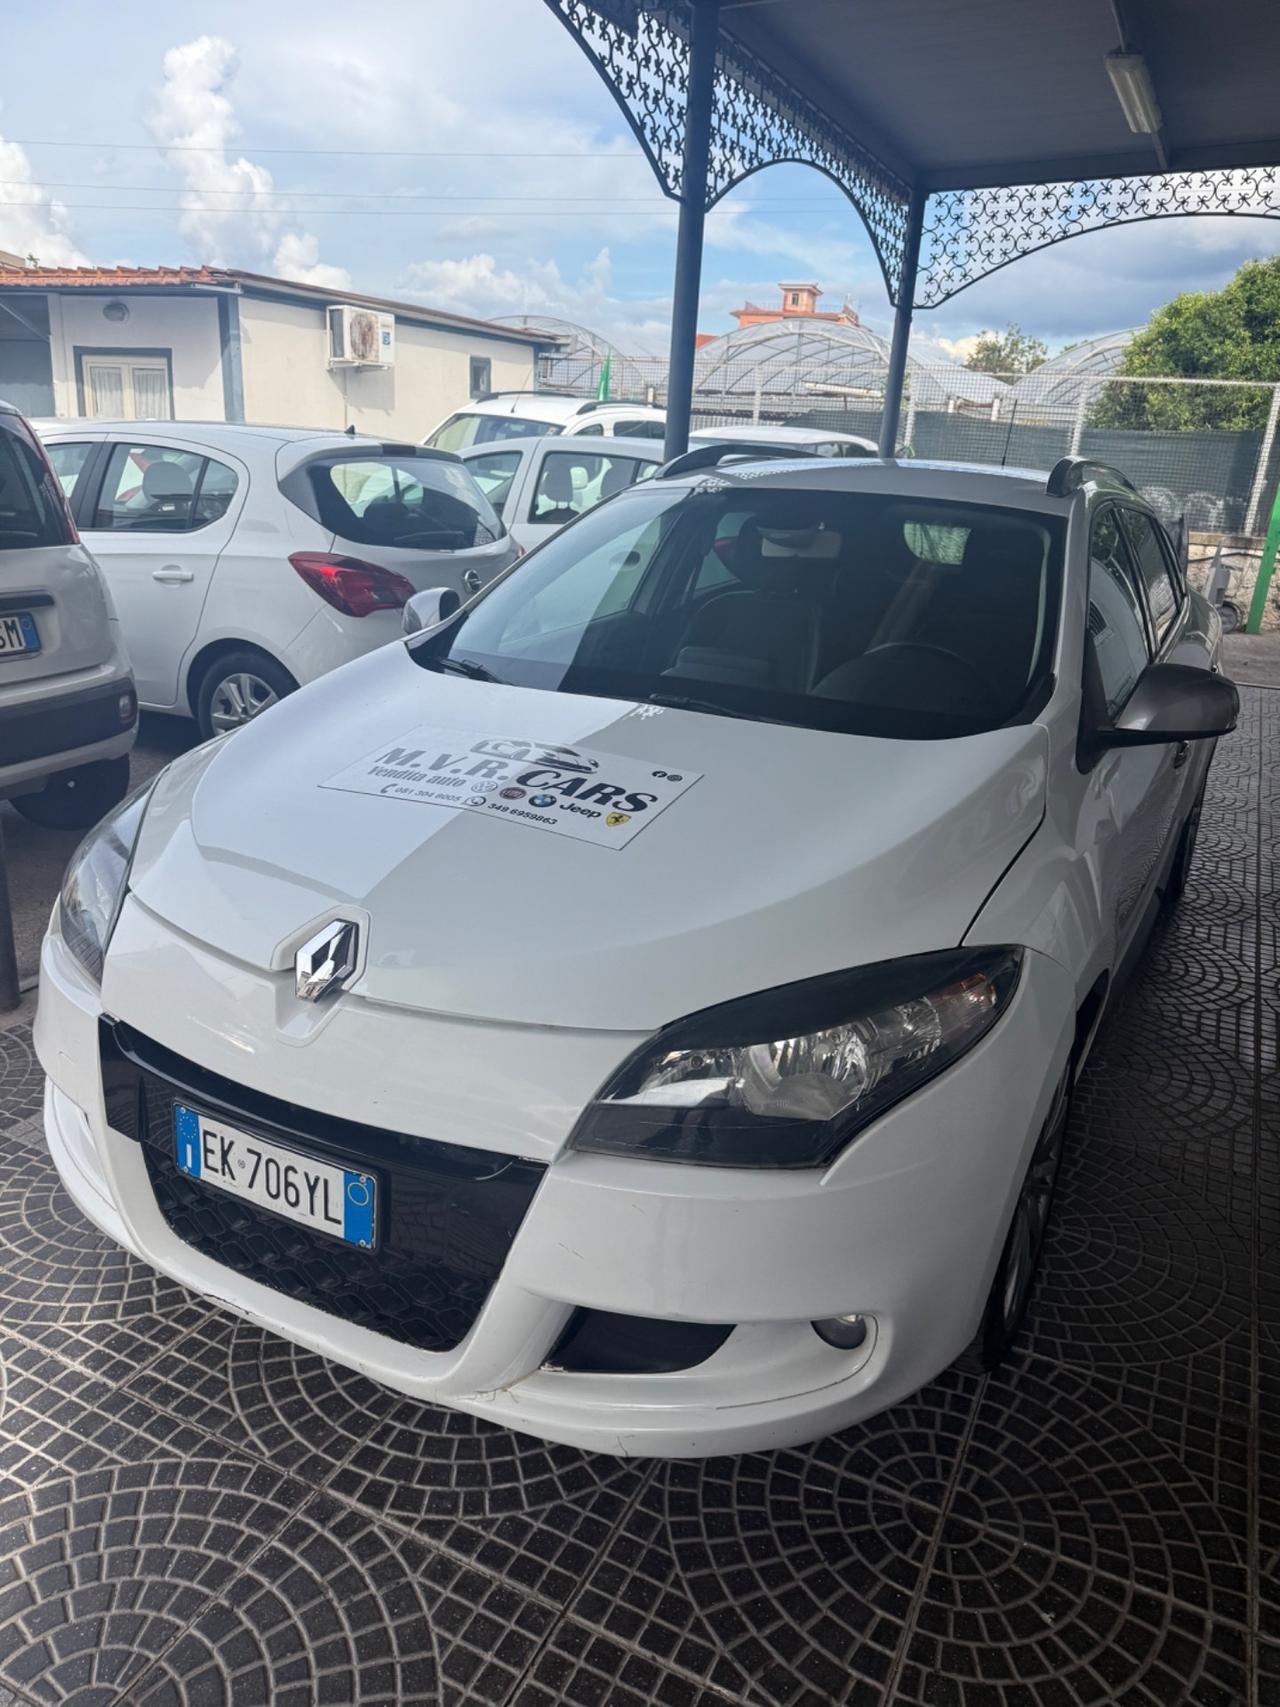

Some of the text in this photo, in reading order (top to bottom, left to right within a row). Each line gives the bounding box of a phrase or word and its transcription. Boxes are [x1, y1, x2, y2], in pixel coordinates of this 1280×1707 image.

[374, 747, 658, 812] M.V.R. CARS
[425, 775, 467, 787] auto
[559, 802, 602, 819] Jeep
[202, 1129, 236, 1181] EK
[247, 1148, 342, 1225] 706YL
